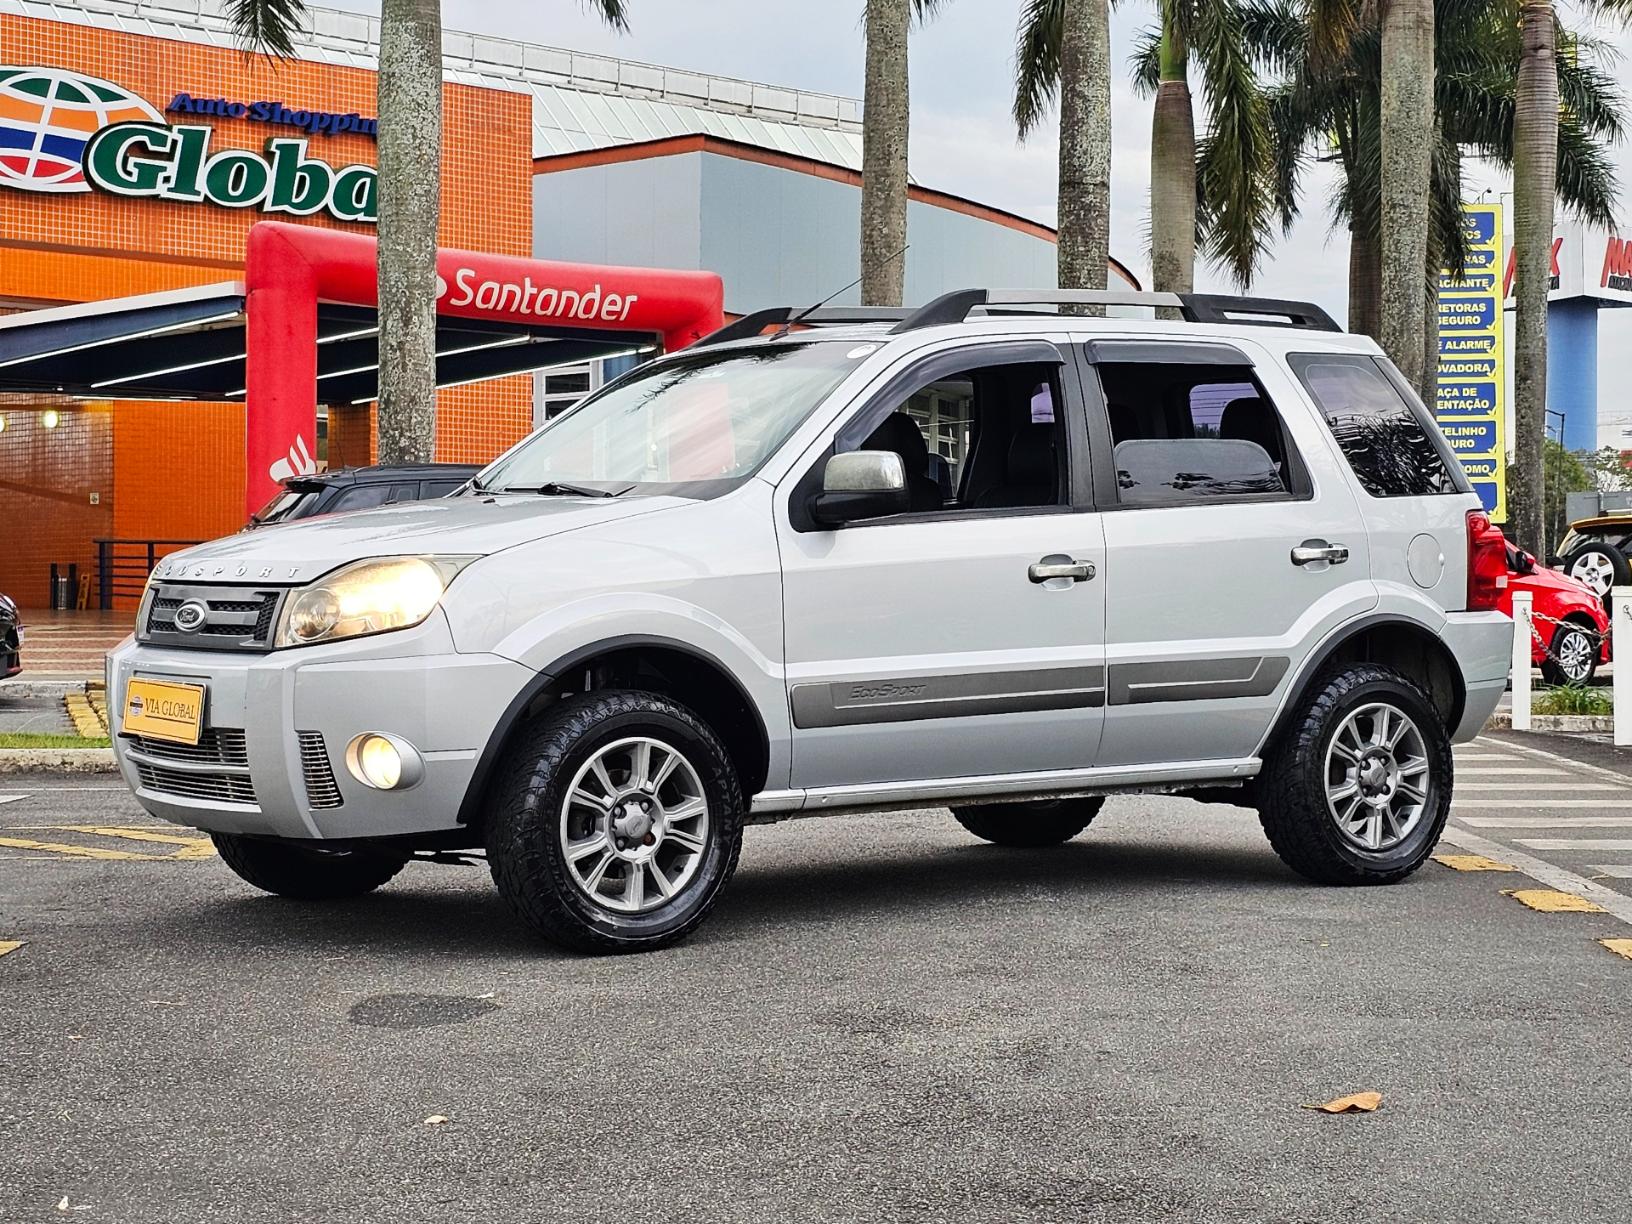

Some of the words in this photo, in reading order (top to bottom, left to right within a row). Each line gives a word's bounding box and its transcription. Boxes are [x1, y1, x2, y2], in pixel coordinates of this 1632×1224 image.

[166, 93, 246, 117] Auto
[450, 268, 637, 321] Santander
[1445, 341, 1491, 350] ALARME
[1463, 388, 1477, 397] DE
[1437, 399, 1490, 411] ENTAÇÃO
[180, 607, 196, 622] Ford
[145, 698, 160, 714] VIA
[162, 700, 196, 719] GLOBAL
